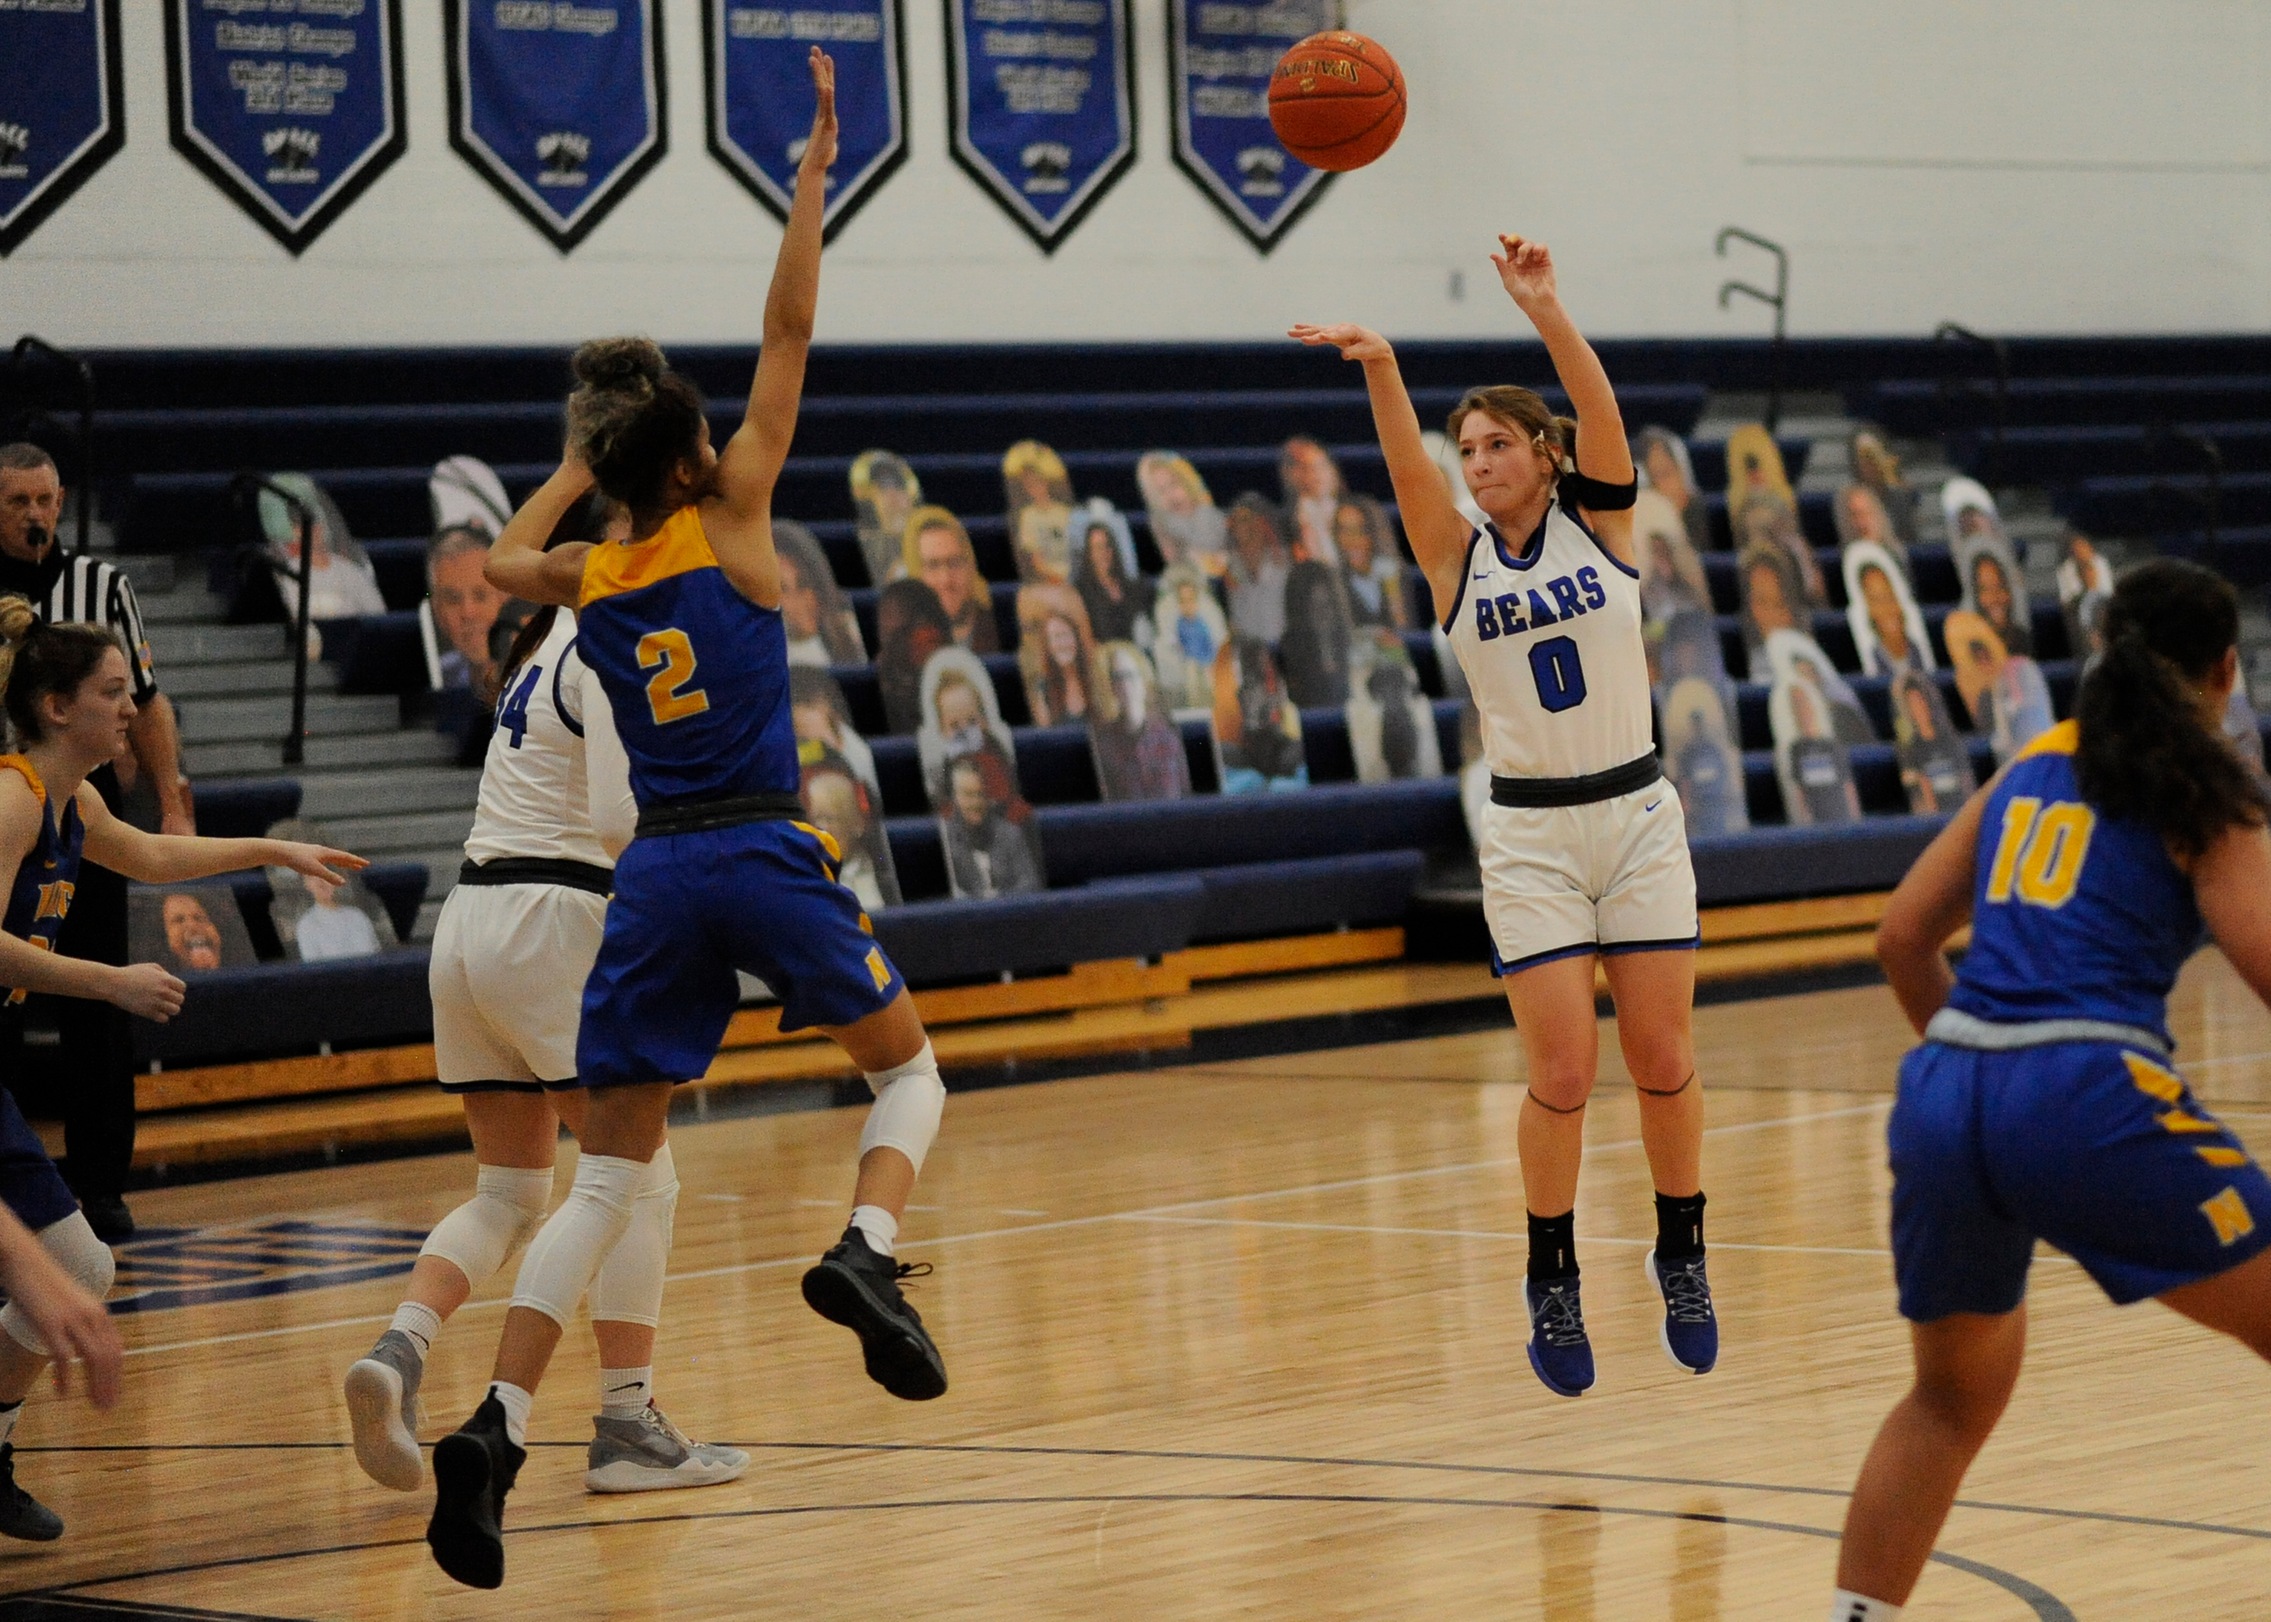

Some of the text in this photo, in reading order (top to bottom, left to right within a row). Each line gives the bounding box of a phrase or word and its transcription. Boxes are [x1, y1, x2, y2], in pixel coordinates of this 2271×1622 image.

[1475, 565, 1607, 642] BEARS
[635, 627, 710, 726] 2
[1527, 634, 1588, 714] 0
[1985, 796, 2096, 909] 10
